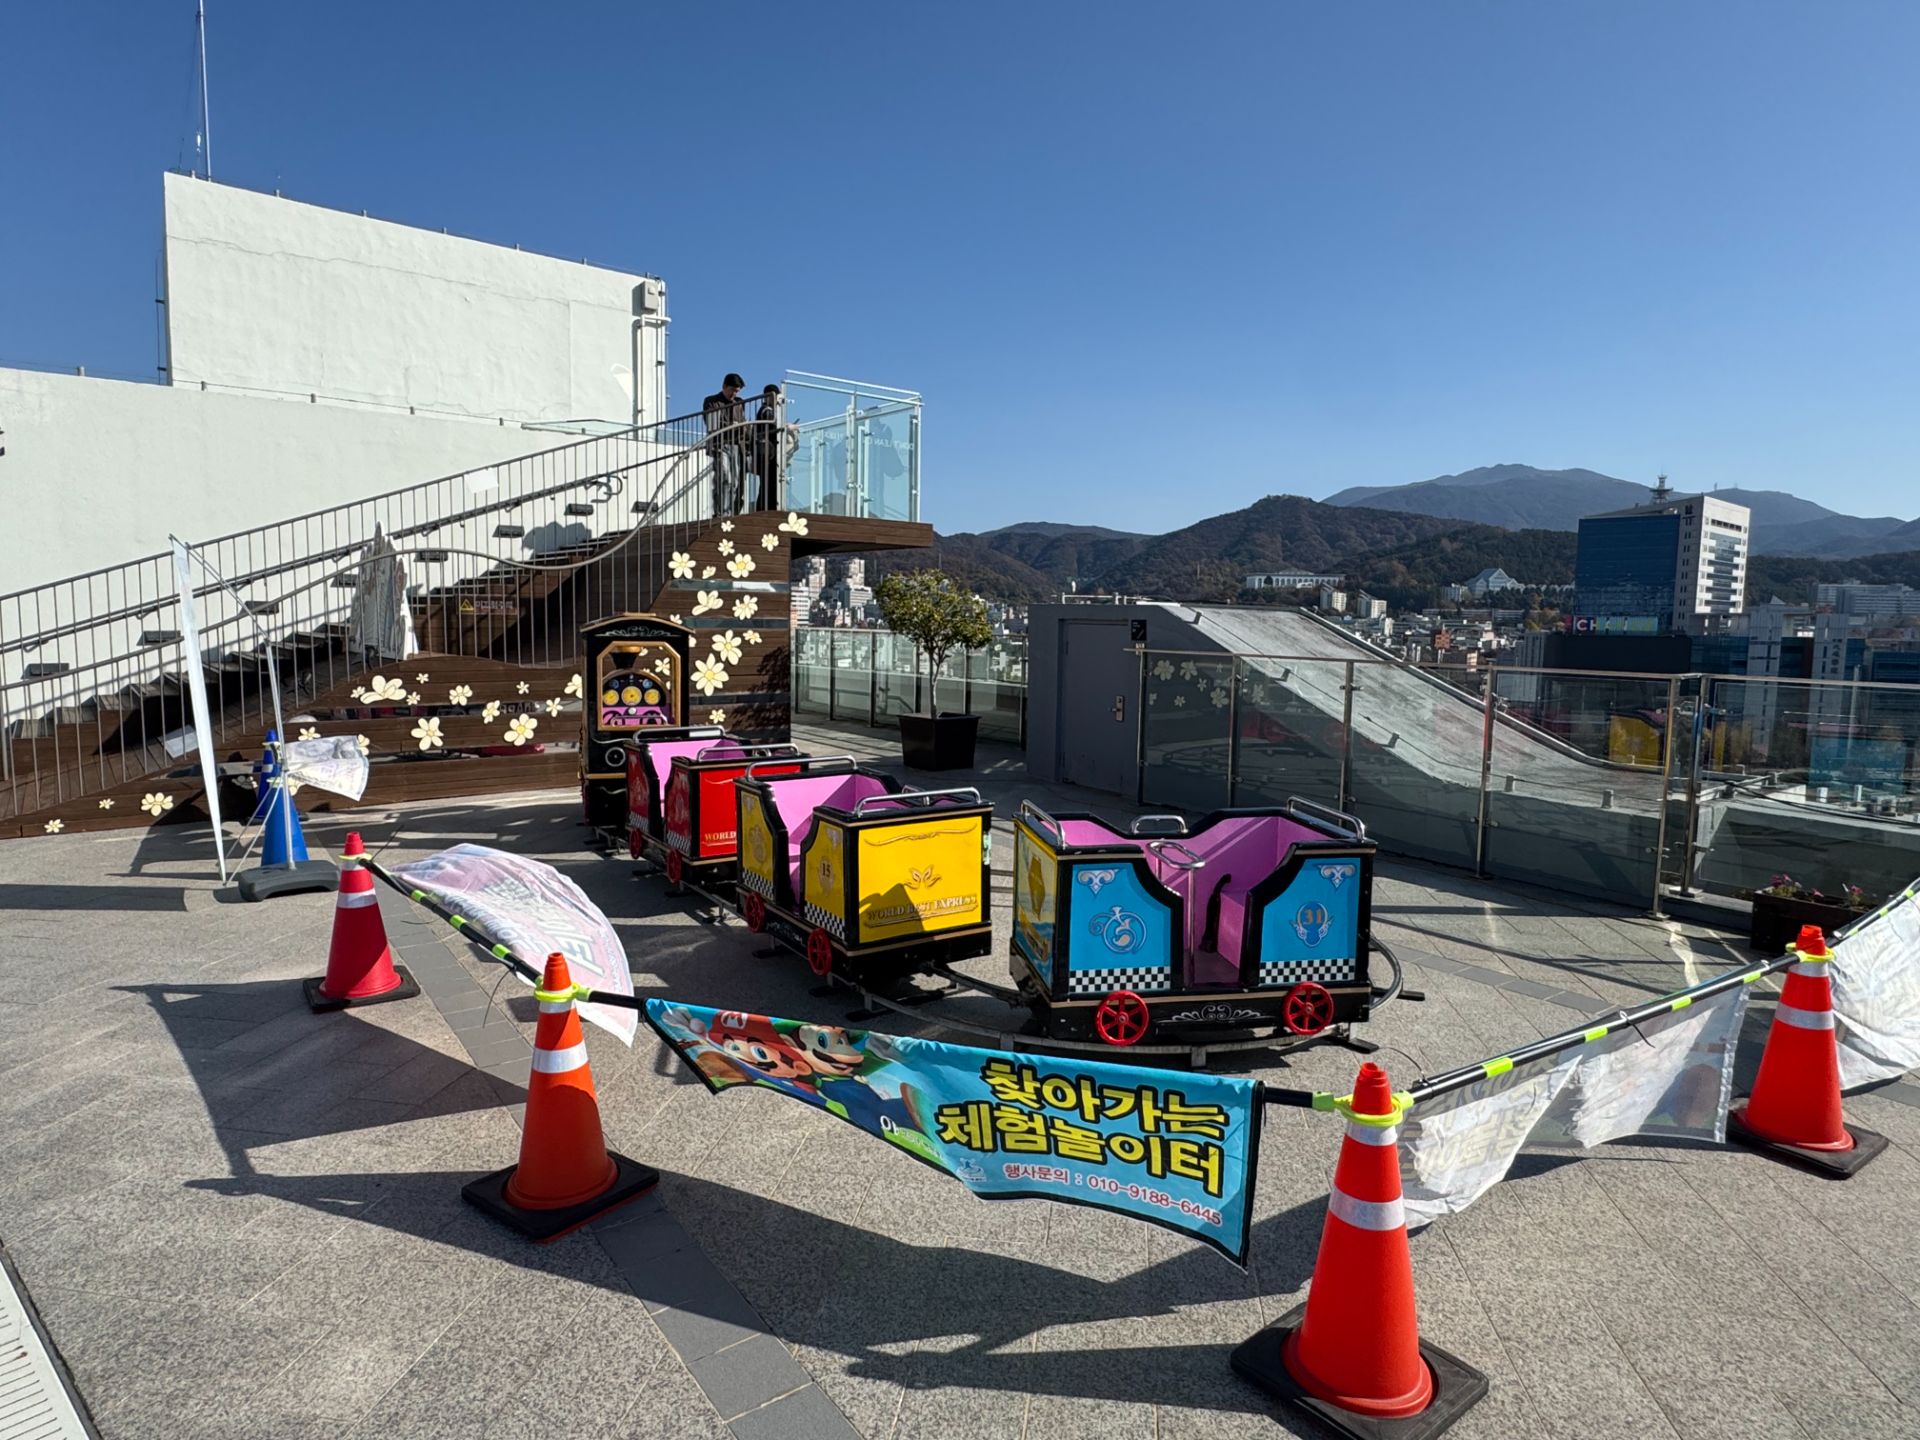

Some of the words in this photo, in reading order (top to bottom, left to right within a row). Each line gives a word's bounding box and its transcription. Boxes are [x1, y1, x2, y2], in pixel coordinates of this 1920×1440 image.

[704, 831, 737, 841] WORLD
[868, 907, 905, 921] WORLD
[1302, 908, 1323, 925] 31
[981, 1058, 1228, 1139] 찾아가는
[936, 1100, 1224, 1196] 체험놀이터
[1003, 1163, 1069, 1184] 행사문의
[1087, 1174, 1222, 1226] 010-9188-6445
